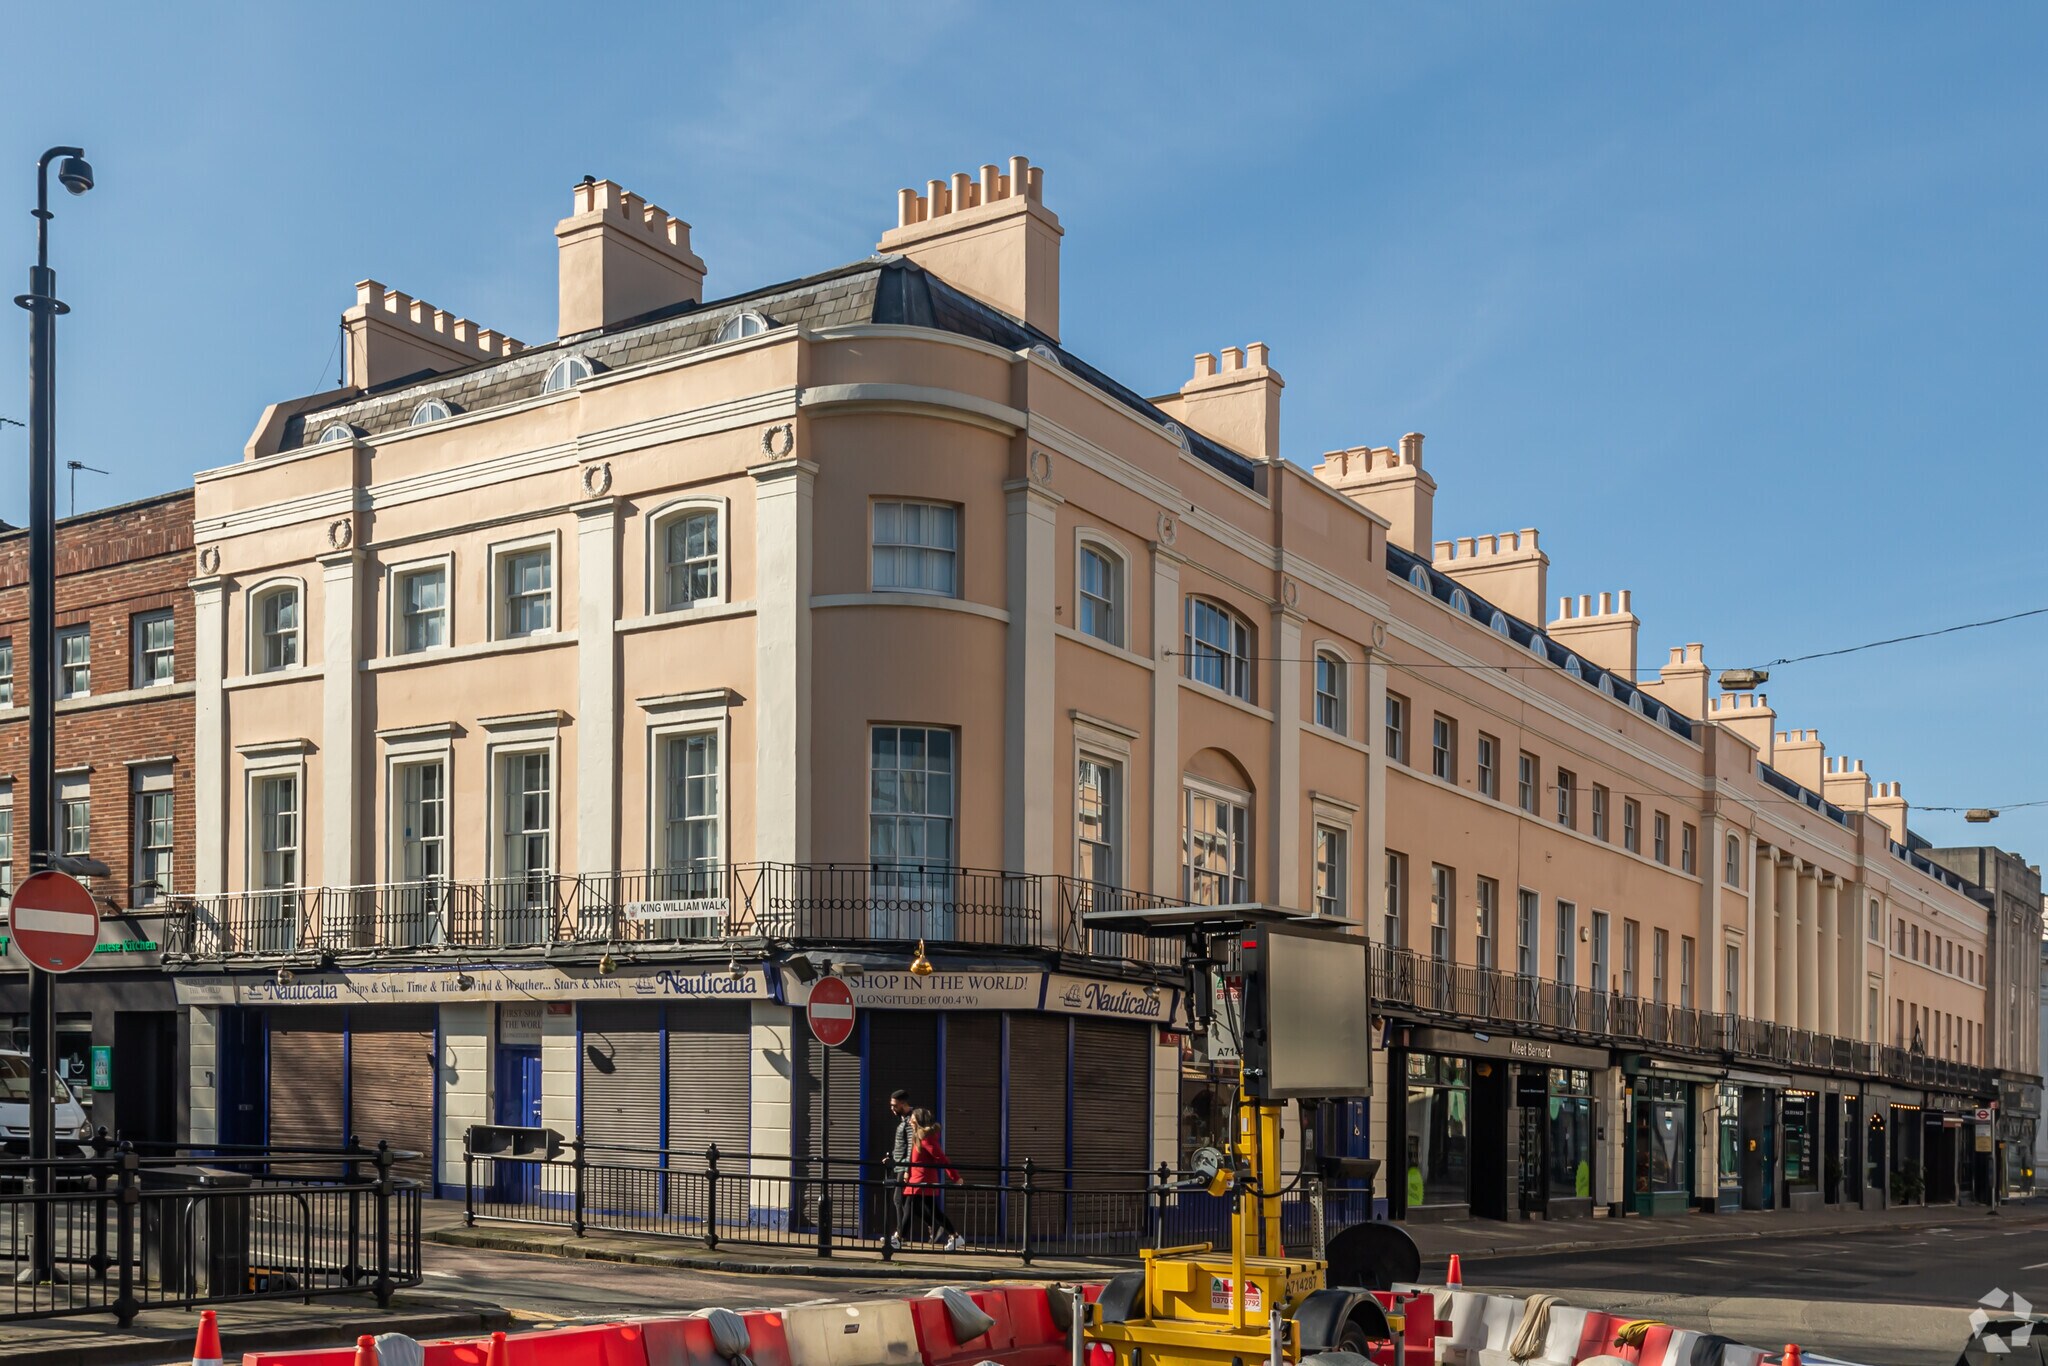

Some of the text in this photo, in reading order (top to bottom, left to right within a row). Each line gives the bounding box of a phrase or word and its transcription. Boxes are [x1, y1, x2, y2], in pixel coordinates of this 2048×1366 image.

[640, 900, 727, 913] KING WILLIAM WALK
[264, 979, 338, 1000] Nauticalia
[346, 981, 369, 994] Ships
[371, 981, 379, 993] &
[406, 981, 428, 992] Time
[429, 981, 438, 992] &
[495, 980, 503, 991] &
[506, 979, 551, 991] Weather...
[554, 978, 579, 990] Stars
[581, 978, 590, 990] &
[655, 969, 757, 994] Nauticalia
[851, 974, 899, 990] SHOP
[904, 975, 923, 990] IN
[928, 975, 964, 990] THE
[968, 976, 1028, 990] WORLD!
[856, 995, 926, 1005] (LONGITUDE
[1084, 983, 1161, 1017] Nauticalia
[502, 1008, 522, 1017] FIRST
[504, 1020, 543, 1029] THE WORL
[1511, 1040, 1527, 1056] Meet
[1285, 1275, 1317, 1295] A714287
[1212, 1297, 1229, 1305] 0370
